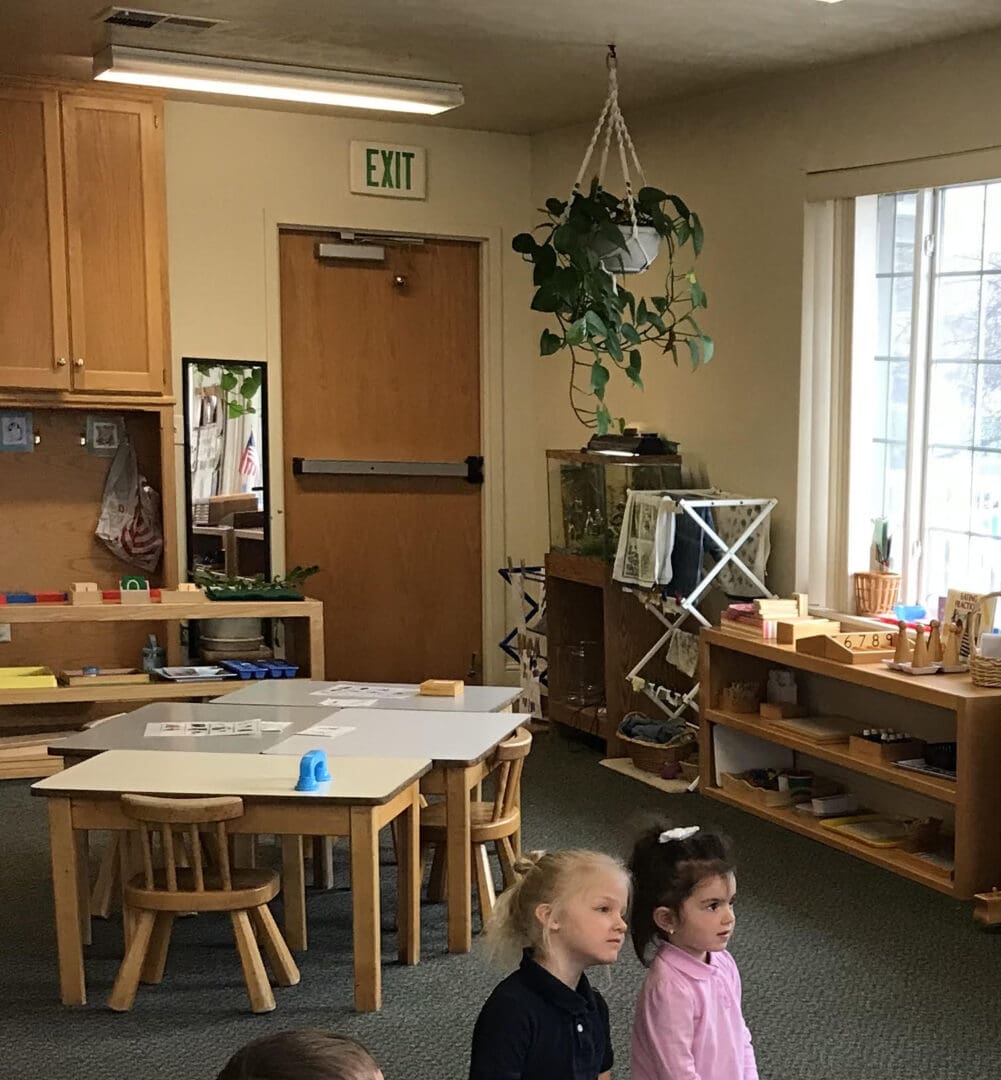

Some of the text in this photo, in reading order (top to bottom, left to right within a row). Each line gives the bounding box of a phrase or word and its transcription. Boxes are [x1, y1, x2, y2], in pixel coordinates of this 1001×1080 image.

[366, 148, 415, 190] EXIT
[844, 633, 893, 648] 6 7 8 9
